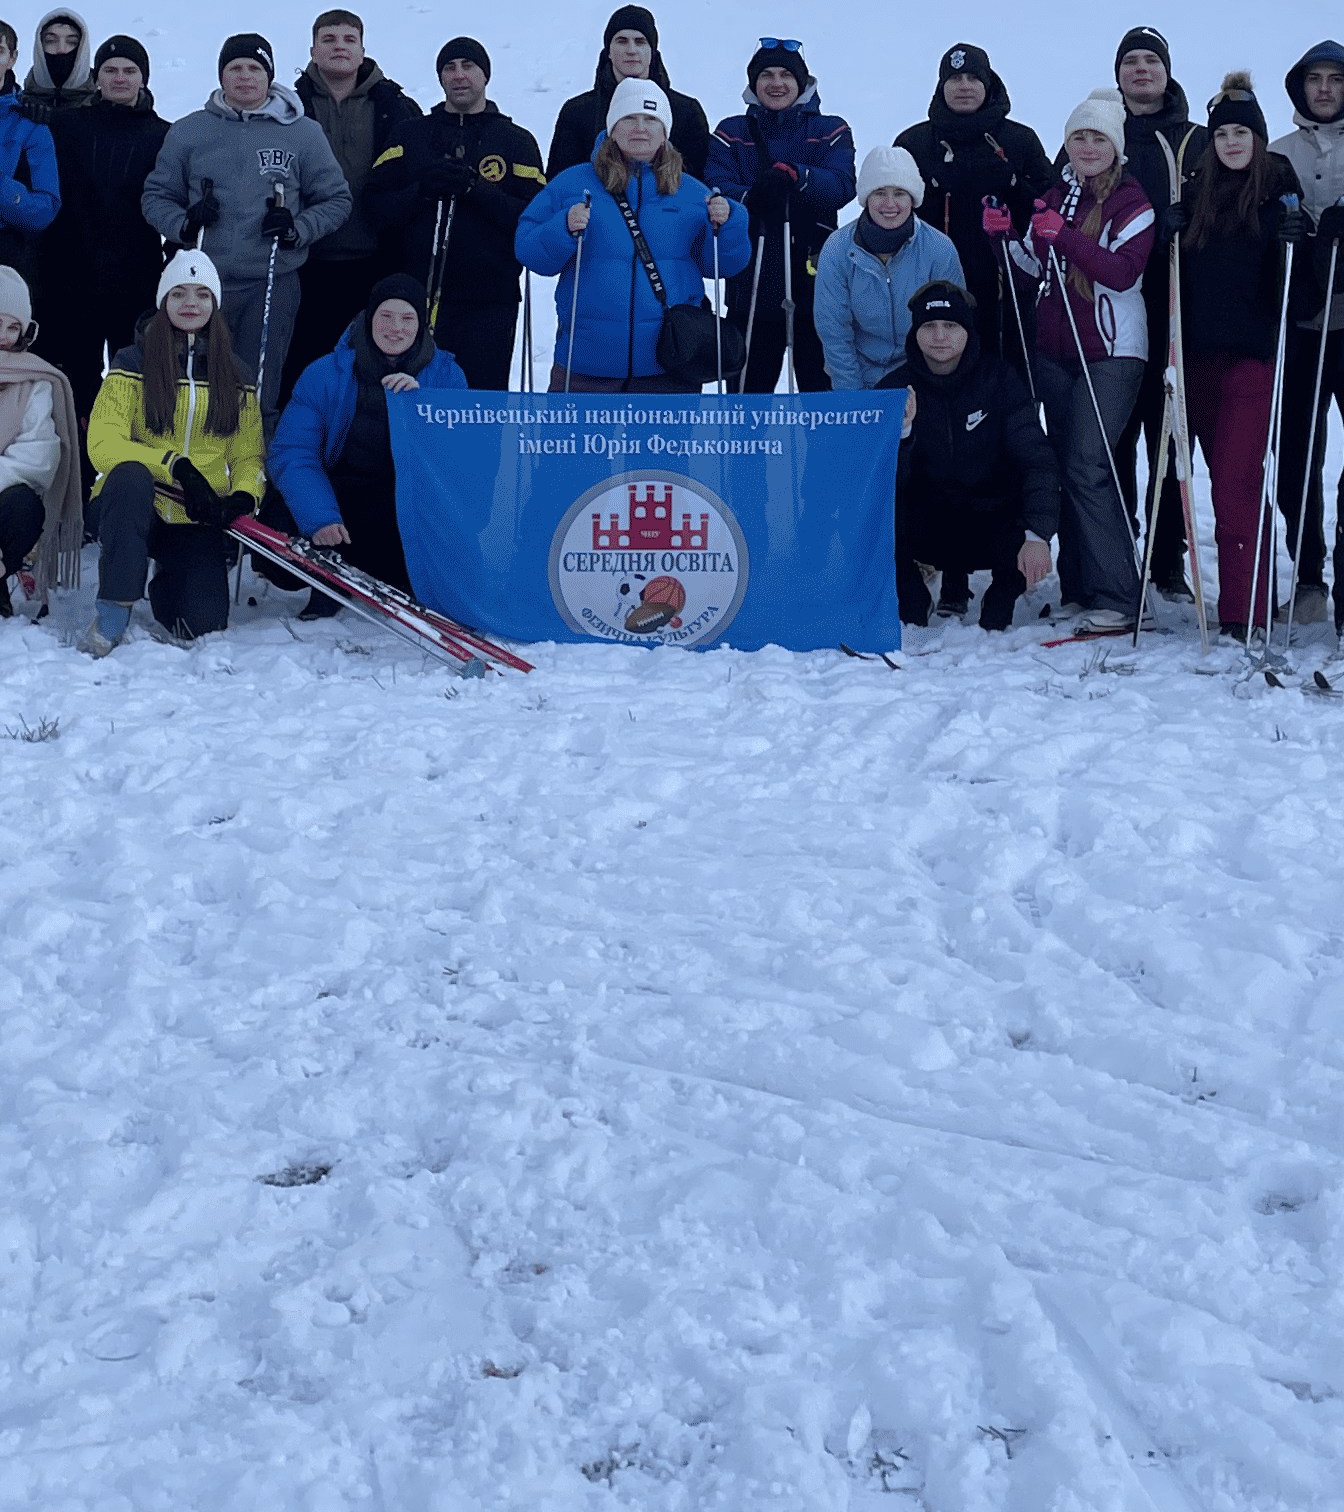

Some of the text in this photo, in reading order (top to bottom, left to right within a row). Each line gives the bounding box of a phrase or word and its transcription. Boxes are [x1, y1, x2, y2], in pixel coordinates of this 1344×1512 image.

[257, 148, 295, 170] FBI
[619, 202, 641, 238] PUMA
[416, 402, 884, 431] Чернівецький національний університет
[518, 433, 783, 460] імені Юрія Федьковича
[563, 551, 734, 576] СЕРЕДНЯ ОСВІТА
